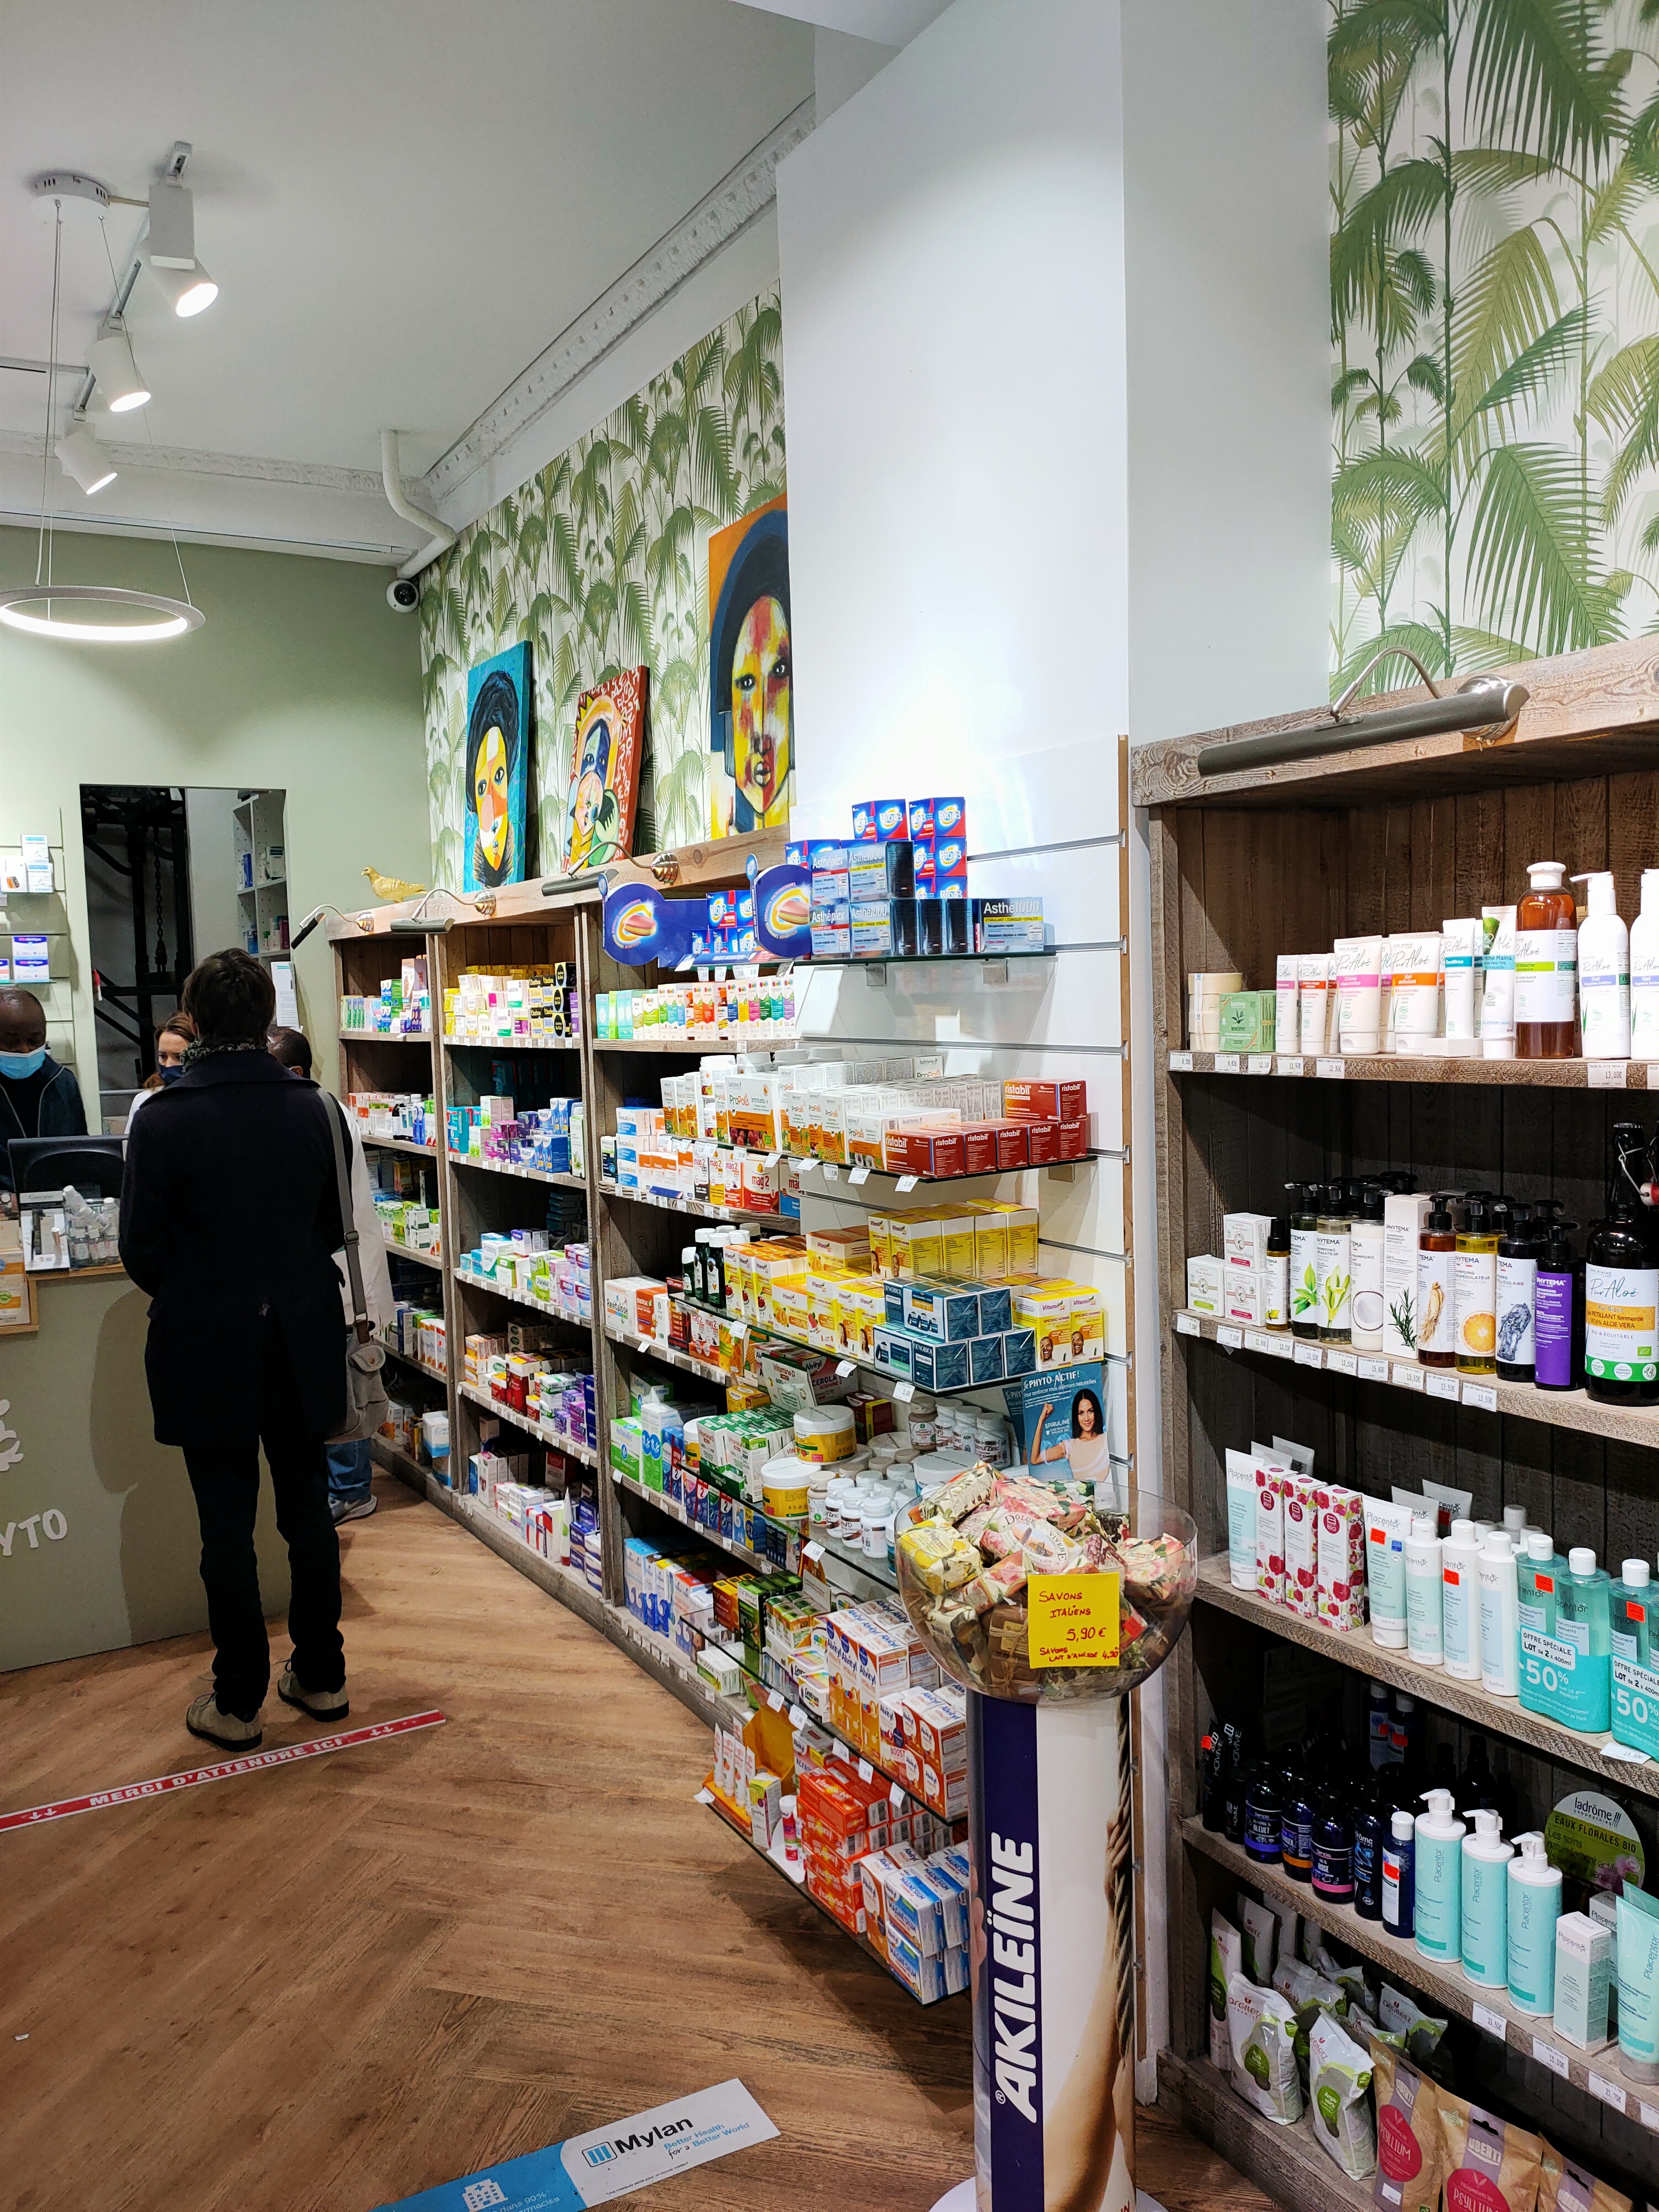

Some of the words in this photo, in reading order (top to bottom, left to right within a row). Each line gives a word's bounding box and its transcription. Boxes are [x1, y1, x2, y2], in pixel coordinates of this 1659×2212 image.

[880, 812, 903, 824] Bion3
[938, 810, 961, 821] Bion3
[939, 850, 962, 860] Bion3
[710, 903, 727, 915] Bion3
[984, 901, 1040, 914] Asthé1000
[752, 1176, 764, 1189] mag
[765, 1176, 769, 1187] 2
[1537, 1277, 1564, 1286] PHYTEMA
[607, 1299, 628, 1314] Revitalose
[1592, 1311, 1616, 1319] PETILLANT
[812, 1375, 837, 1387] CEROLA
[1045, 1419, 1070, 1428] SPIRULINE
[1004, 1514, 1036, 1526] DOLCE
[1049, 1530, 1067, 1561] VIVERE
[1039, 1591, 1082, 1602] SAVONS
[1523, 1633, 1542, 1644] OFFRE
[1543, 1639, 1572, 1656] SPÉCIALE
[1524, 1641, 1536, 1652] LOT
[1545, 1649, 1550, 1657] 2
[1554, 1656, 1572, 1666] 400ml
[1614, 1661, 1631, 1673] OFFRE
[860, 1665, 876, 1685] Alvityl
[1615, 1671, 1626, 1682] LOT
[1645, 1685, 1659, 1697] 400m
[805, 1688, 818, 1704] Centrum
[890, 1746, 905, 1758] BOOST
[89, 1782, 164, 1807] MERCI
[171, 1747, 306, 1787] D'ATTENDRE
[312, 1738, 343, 1753] ICI
[1574, 1797, 1612, 1820] ladrôme
[1548, 1828, 1561, 1840] Les
[1563, 1834, 1583, 1849] soins
[1555, 1815, 1576, 1830] EAUX
[1579, 1824, 1619, 1846] FLORALES
[1623, 1841, 1636, 1853] BIO
[1598, 1862, 1618, 1874] actifs
[987, 1832, 1037, 2124] AKILEÏNE
[614, 2119, 694, 2154] Mylan
[664, 2135, 692, 2150] Better
[694, 2124, 724, 2138] Health
[668, 2147, 682, 2159] for
[692, 2134, 721, 2147] Better
[723, 2121, 749, 2136] World
[500, 2200, 523, 2212] dans
[524, 2191, 547, 2203] 90%
